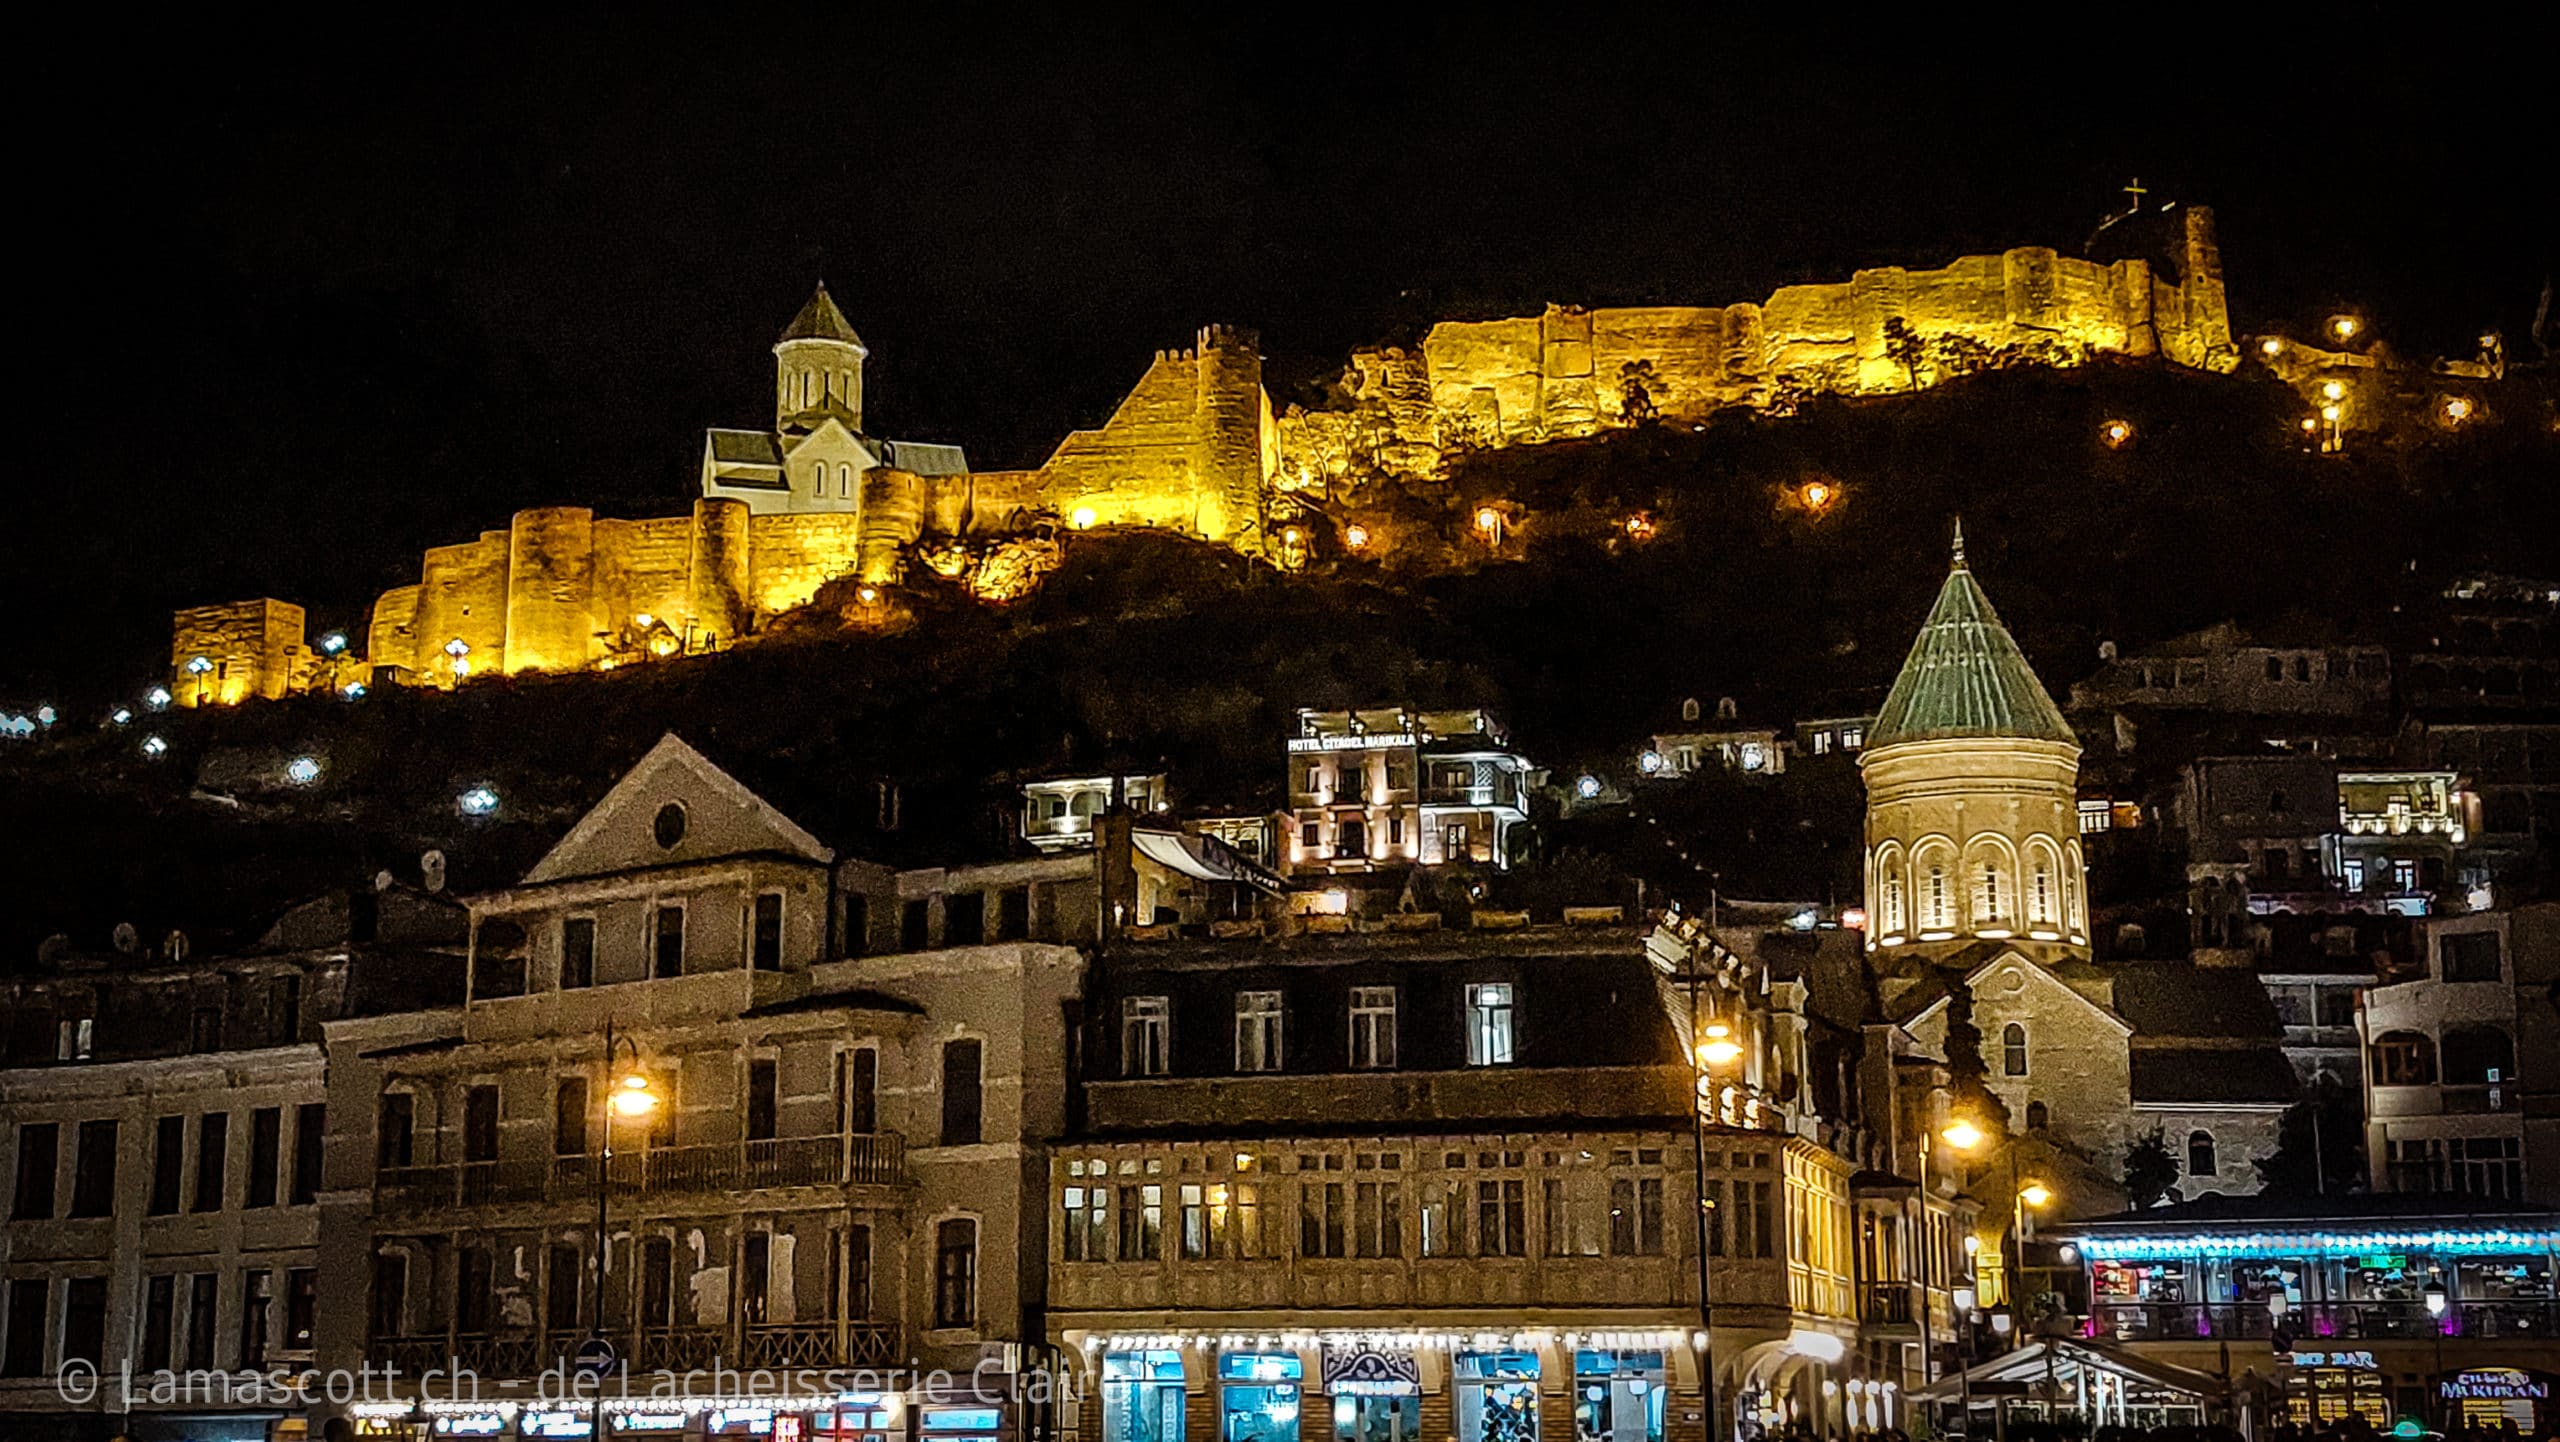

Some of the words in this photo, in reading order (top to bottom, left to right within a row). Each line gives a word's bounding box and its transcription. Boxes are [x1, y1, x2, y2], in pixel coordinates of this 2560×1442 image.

[1288, 739, 1321, 751] HOTEL
[1322, 736, 1364, 750] CITADEL
[1364, 734, 1416, 748] NARIKALA
